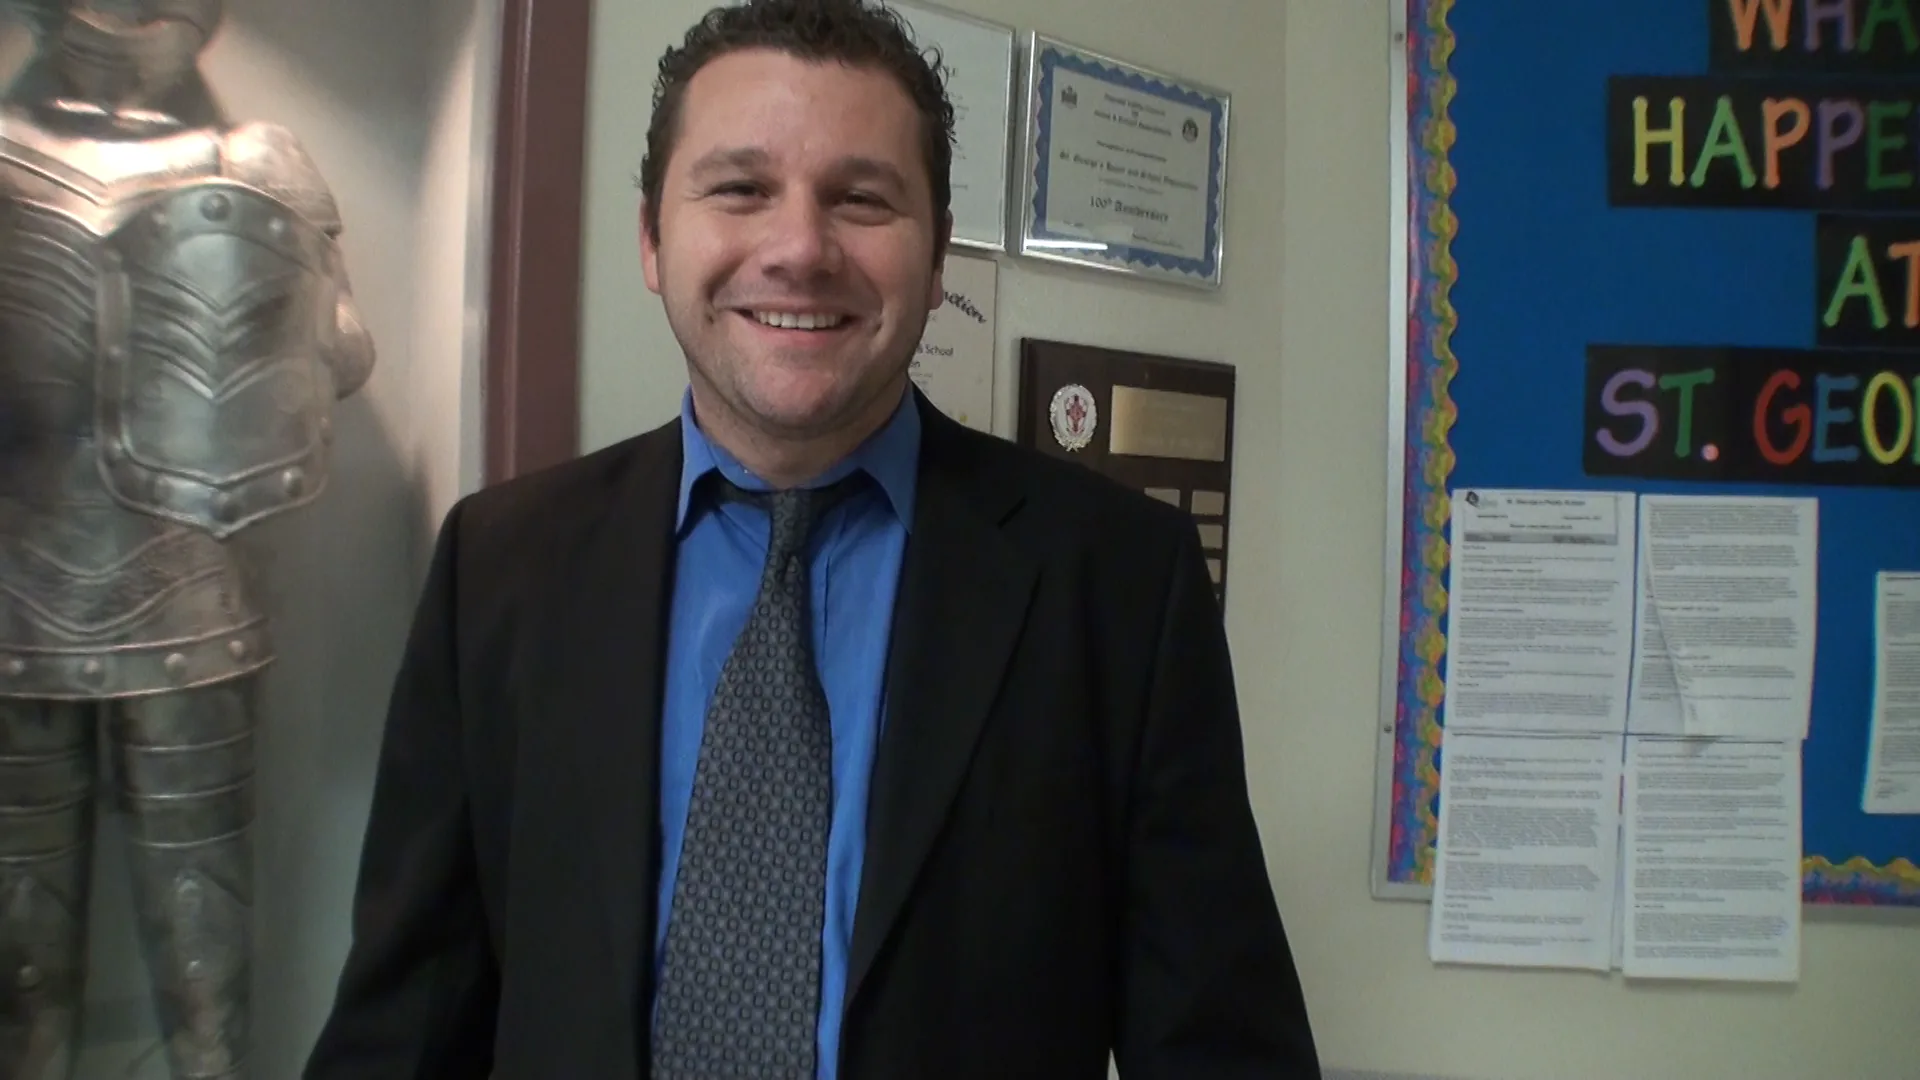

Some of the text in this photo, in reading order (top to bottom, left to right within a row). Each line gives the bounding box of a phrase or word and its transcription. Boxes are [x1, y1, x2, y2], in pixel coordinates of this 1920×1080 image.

[1632, 95, 1920, 190] HAPPE
[1823, 235, 1920, 328] AT
[1596, 367, 1920, 466] ST. GEO
